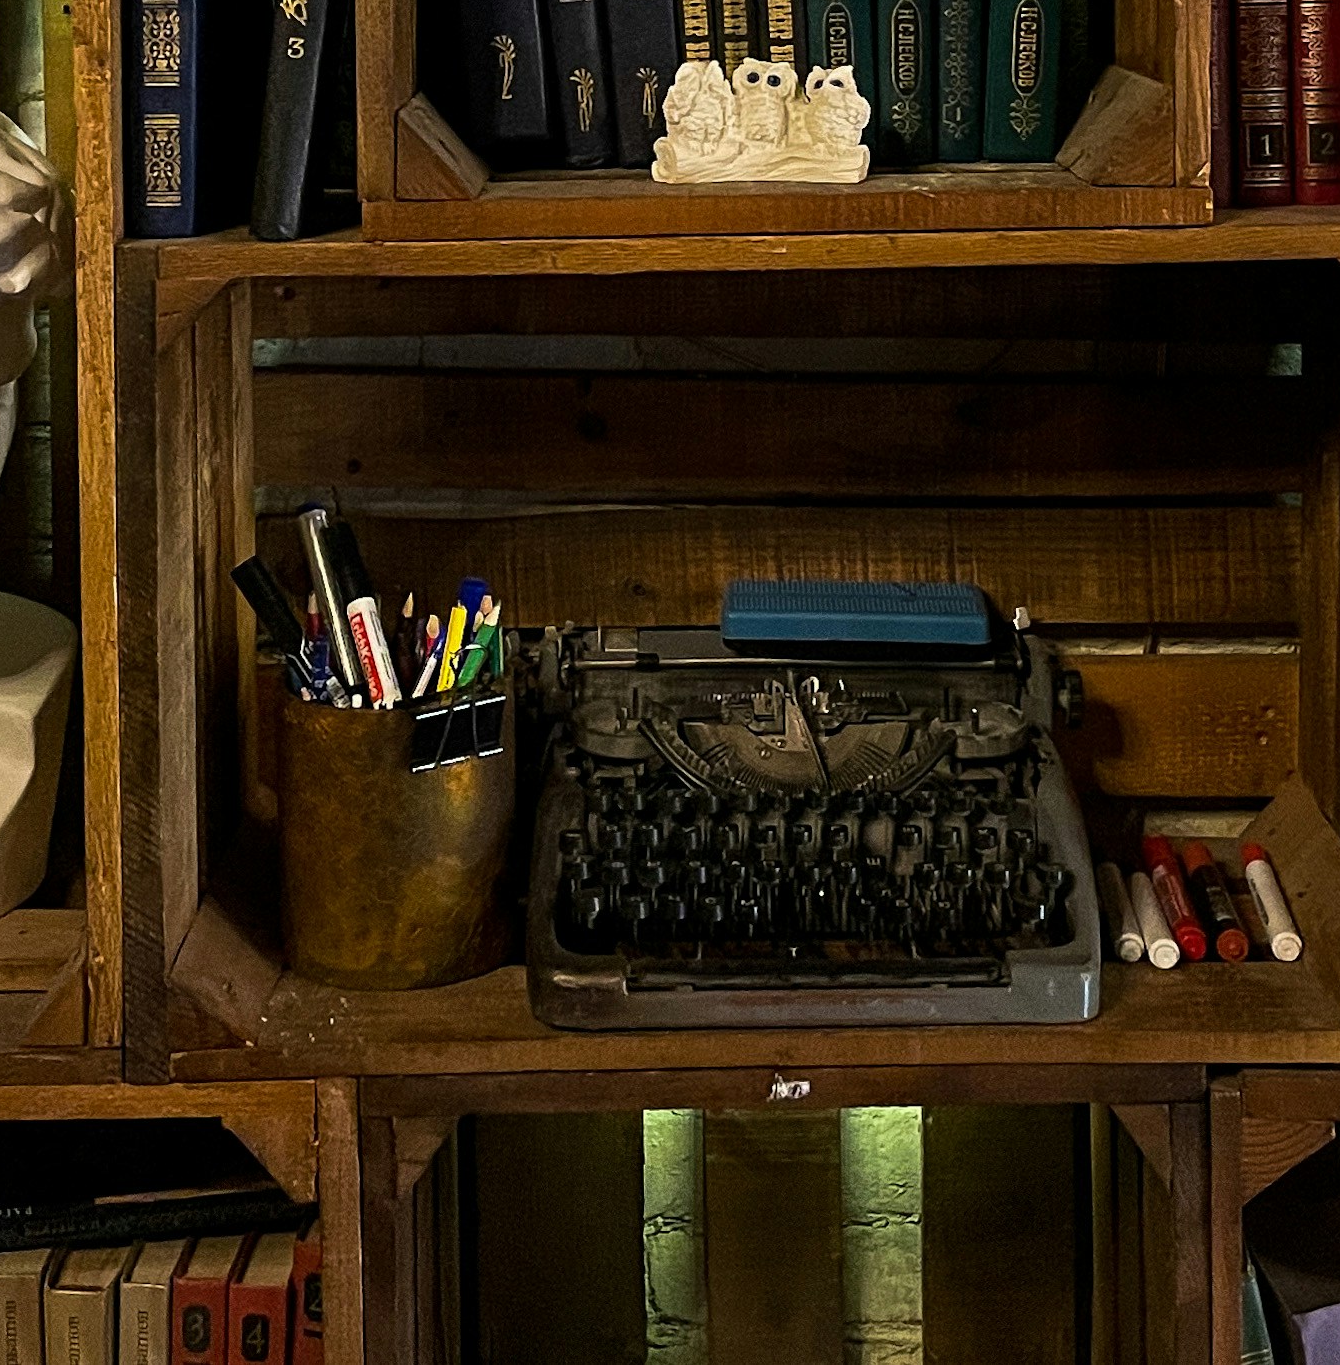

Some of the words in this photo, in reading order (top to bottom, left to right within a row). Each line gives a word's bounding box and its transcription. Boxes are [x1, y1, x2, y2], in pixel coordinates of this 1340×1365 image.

[287, 36, 306, 60] 3
[1259, 133, 1273, 158] 1
[1319, 132, 1335, 157] 2
[187, 1312, 204, 1346] 3
[245, 1319, 266, 1355] 4
